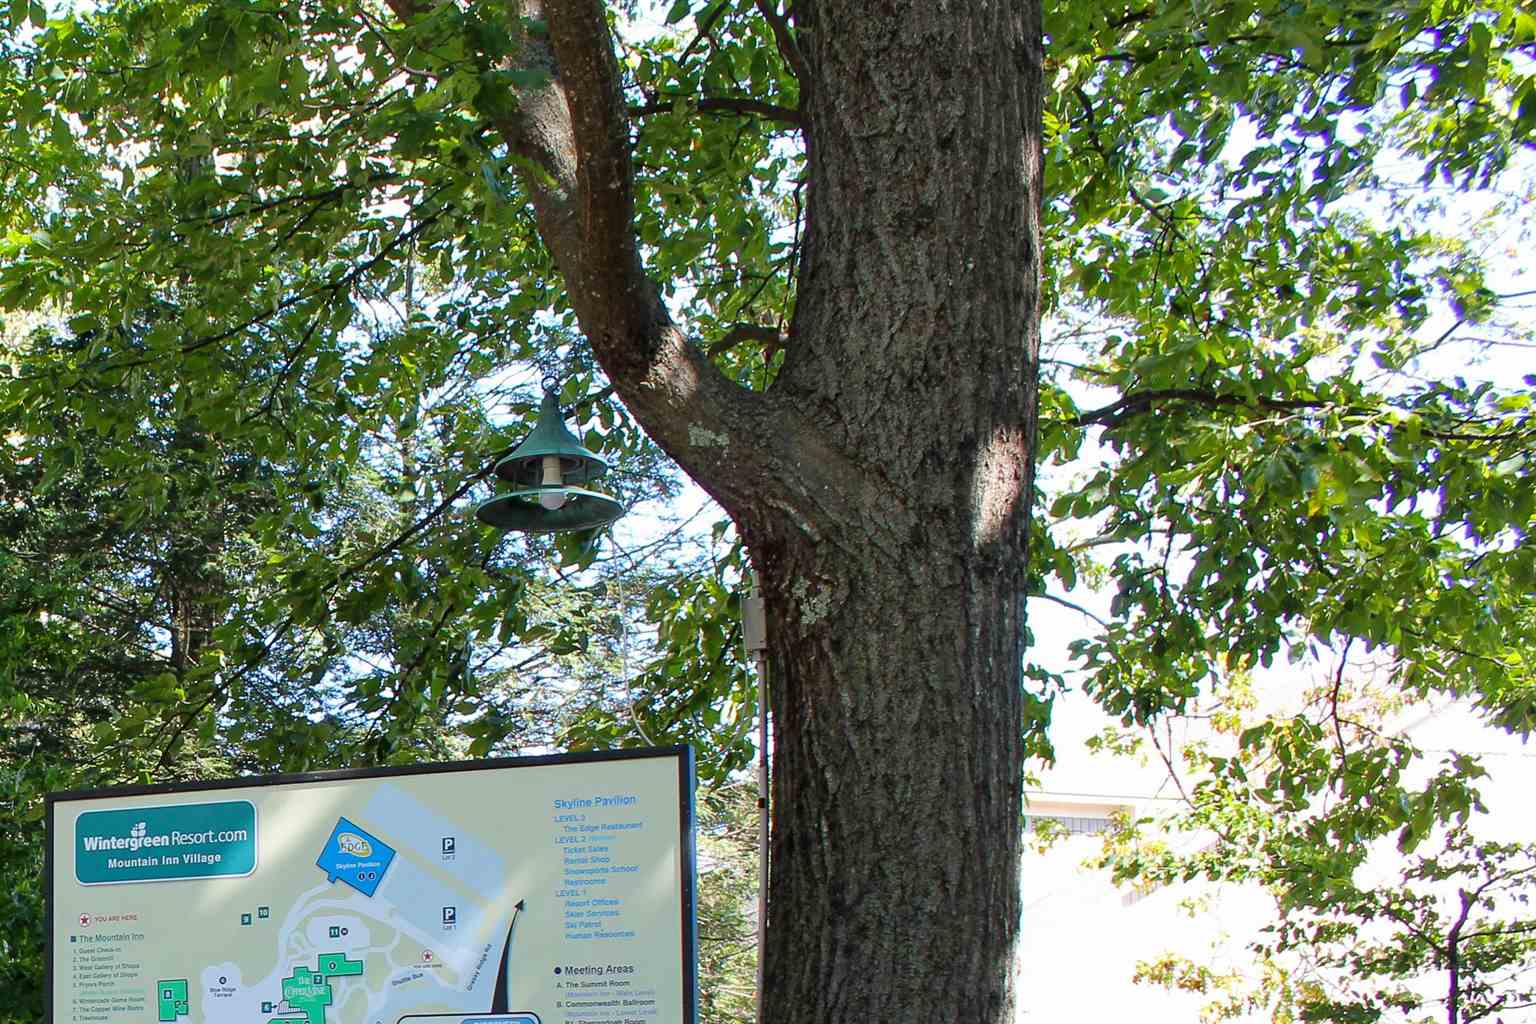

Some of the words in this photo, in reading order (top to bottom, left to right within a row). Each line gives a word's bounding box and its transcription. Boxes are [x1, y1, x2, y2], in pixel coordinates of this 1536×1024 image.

[554, 800, 592, 809] Skyline
[594, 796, 636, 806] Pavilion
[83, 834, 169, 851] Wintergreen
[171, 829, 247, 845] Resort.com
[108, 858, 158, 868] Mountain
[162, 856, 179, 864] Inn
[183, 853, 221, 864] Village
[95, 934, 130, 942] Mountain
[565, 966, 603, 975] Meeting
[606, 965, 634, 974] Areas
